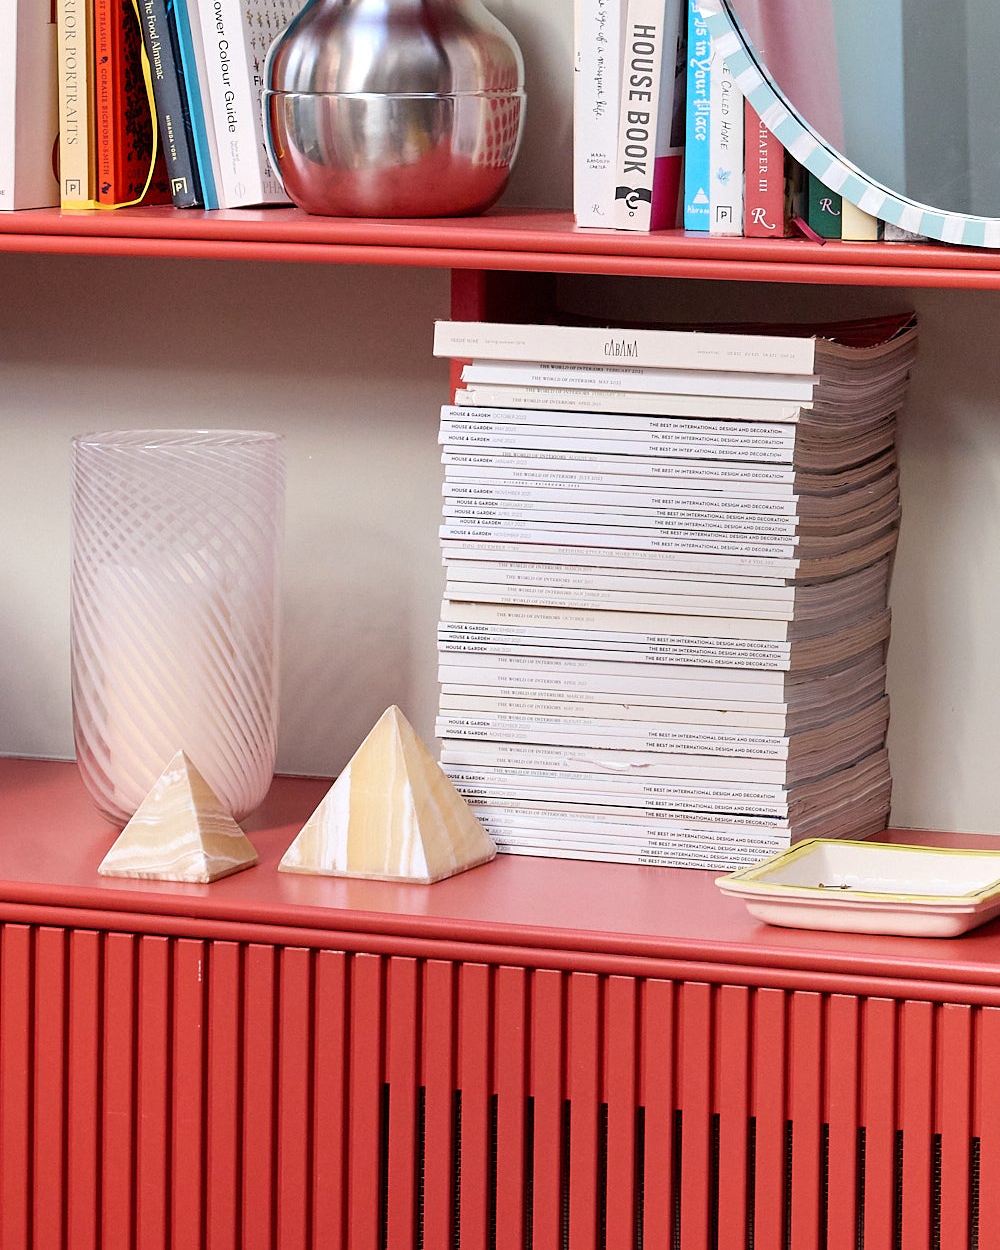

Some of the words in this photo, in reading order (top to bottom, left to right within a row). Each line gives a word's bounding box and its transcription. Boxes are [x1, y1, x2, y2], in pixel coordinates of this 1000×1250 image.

[146, 14, 159, 39] Food
[149, 41, 165, 80] Almanac
[218, 40, 233, 87] Colour
[629, 24, 656, 102] HOUSE
[65, 47, 79, 145] PORTRAITS
[223, 91, 238, 133] Guide
[721, 80, 732, 115] CALLED
[624, 111, 650, 175] BOOK
[720, 120, 732, 150] HOME
[604, 338, 639, 357] CABANA
